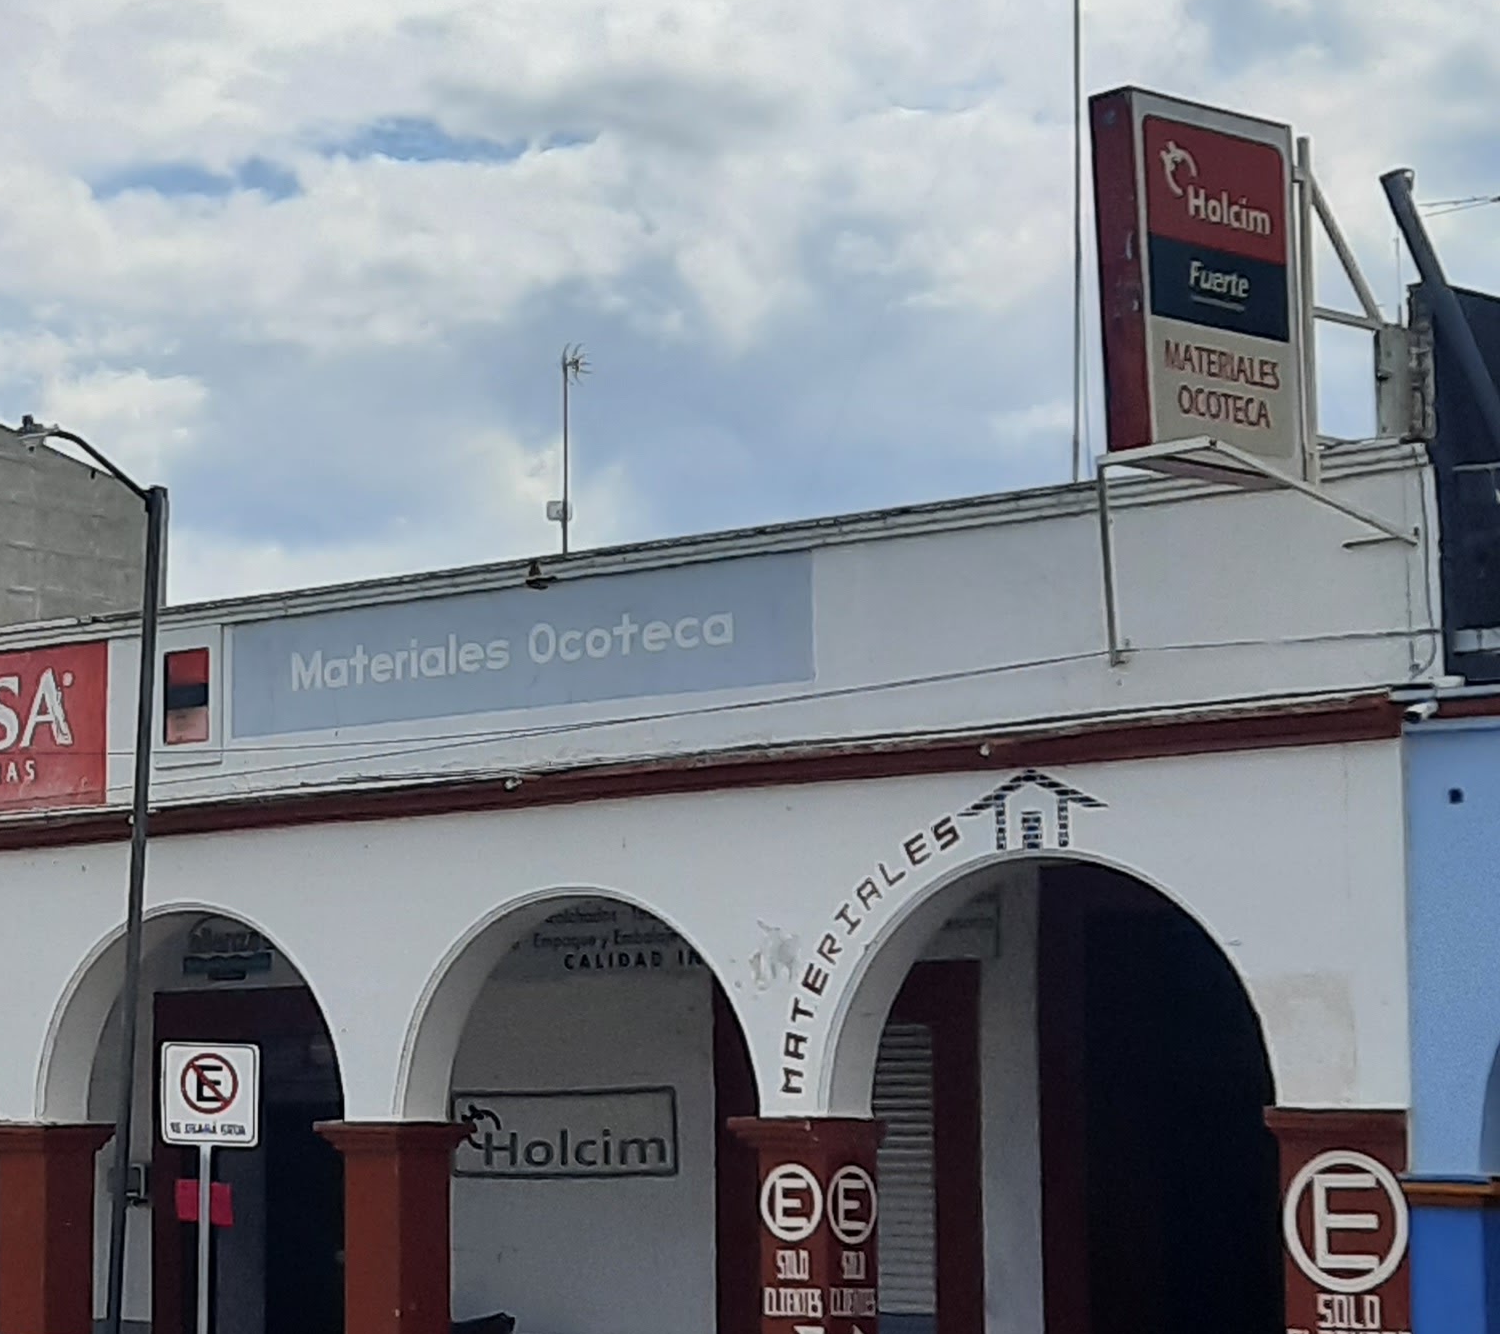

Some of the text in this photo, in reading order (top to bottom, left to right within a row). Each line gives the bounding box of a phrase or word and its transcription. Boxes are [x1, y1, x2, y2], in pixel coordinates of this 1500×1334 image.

[1187, 185, 1271, 235] Holcim
[1189, 260, 1250, 299] Fuerte
[1164, 340, 1279, 389] MATERIALES
[1178, 385, 1270, 429] OCOTECA
[290, 611, 734, 692] Materiales Ocoteca
[564, 952, 663, 970] CALIDAD
[779, 815, 961, 1095] MATERIALES
[483, 1128, 668, 1169] Holcim
[775, 1177, 810, 1228] E
[838, 1179, 867, 1230] E
[1312, 1173, 1380, 1270] E
[1315, 1293, 1381, 1329] SOLO
